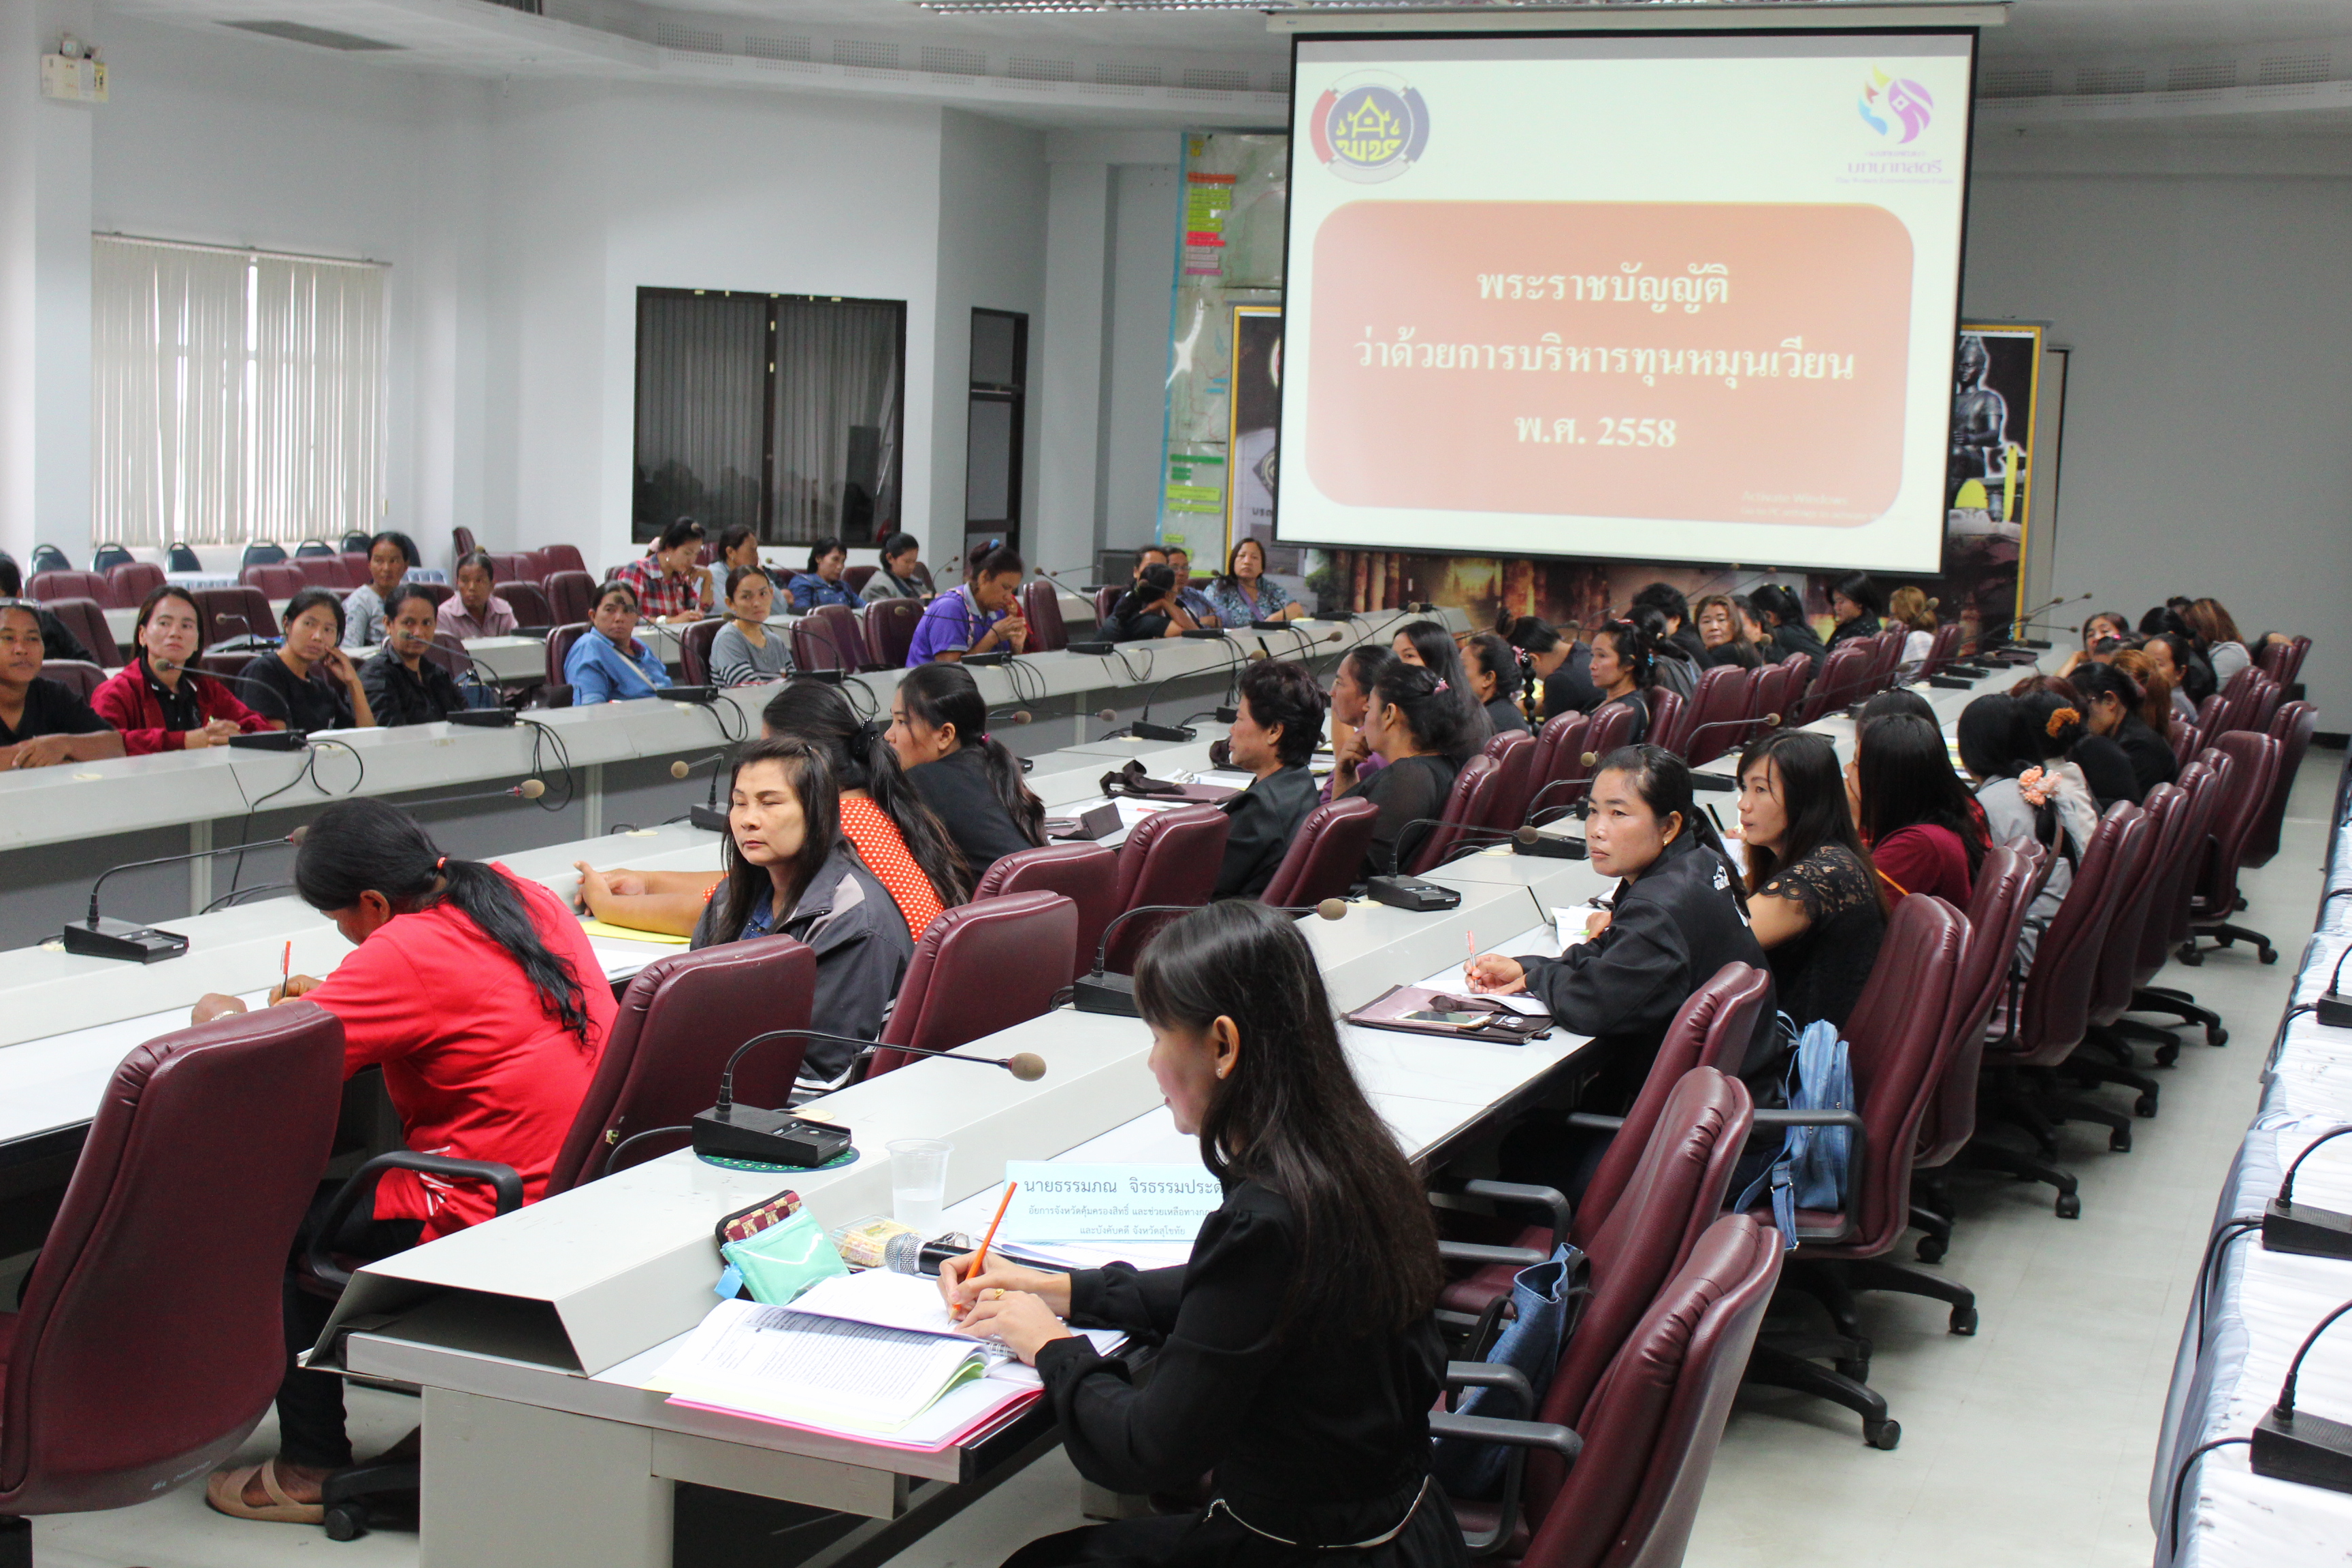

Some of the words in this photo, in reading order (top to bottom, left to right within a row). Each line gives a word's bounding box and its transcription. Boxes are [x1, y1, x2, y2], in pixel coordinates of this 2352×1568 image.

[1476, 261, 1729, 314] พระราชบัญญัติ
[1354, 326, 1855, 389] ว่าด้วยการบริหารทุนหมุนเวียน
[1514, 416, 1586, 444] พ.ศ.
[1597, 416, 1677, 448] 2558
[1024, 1180, 1117, 1193] นายธรรมภณ
[1028, 1203, 1130, 1218] อัยการจังหวัดคุ้มครองสิทธิ์
[1132, 1225, 1186, 1238] จังหวัดสุโขทัย
